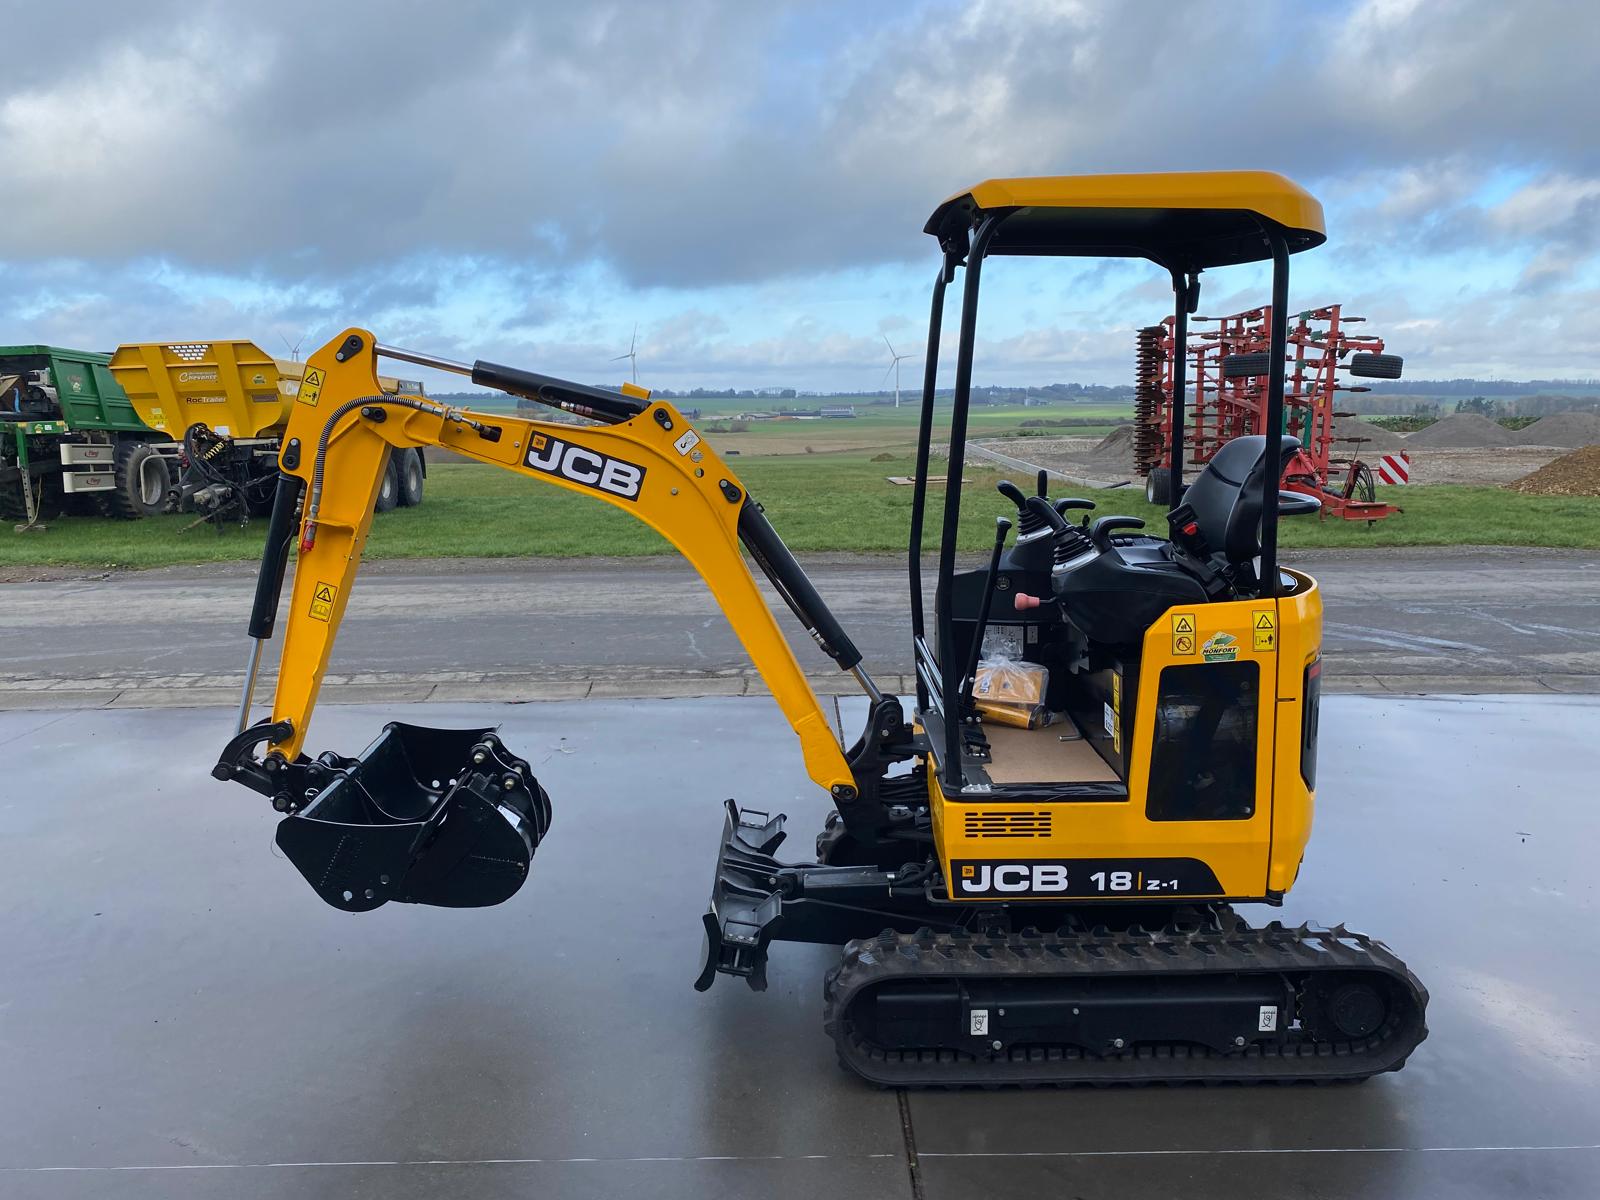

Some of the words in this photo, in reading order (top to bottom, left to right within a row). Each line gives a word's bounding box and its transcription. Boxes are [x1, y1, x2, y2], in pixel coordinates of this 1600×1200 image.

[528, 440, 641, 497] JCB
[1203, 647, 1237, 655] MONFORT
[962, 865, 1068, 892] JCB
[1090, 872, 1132, 890] 18
